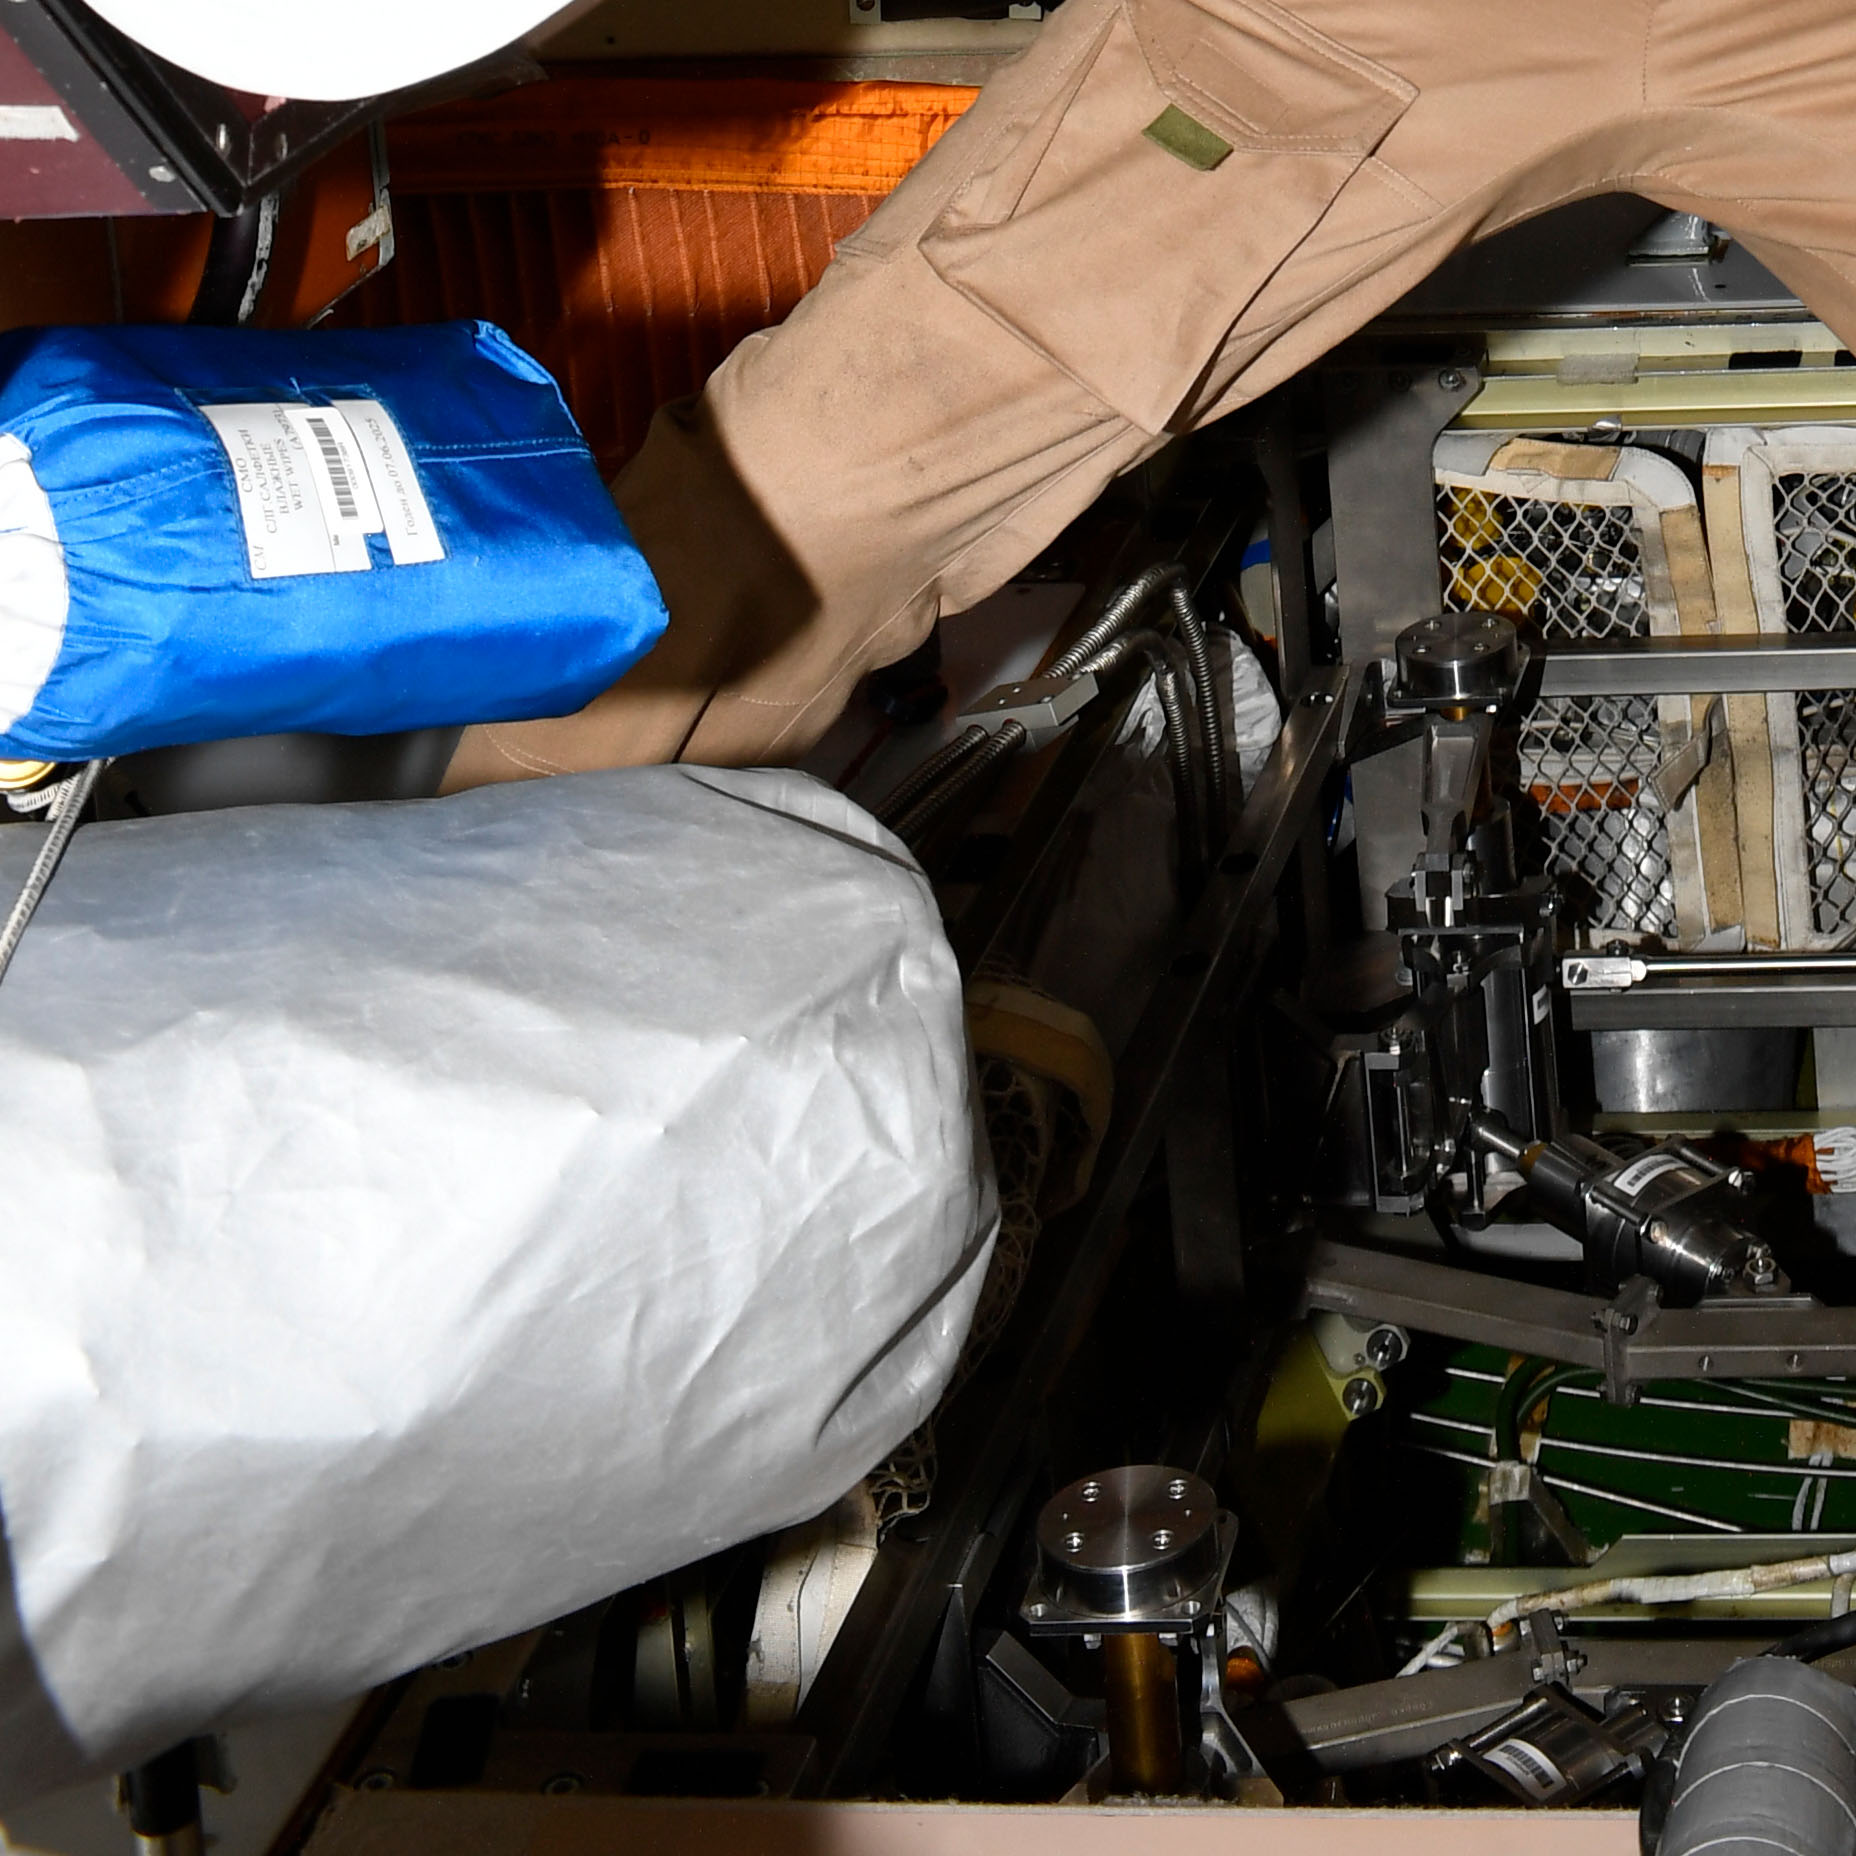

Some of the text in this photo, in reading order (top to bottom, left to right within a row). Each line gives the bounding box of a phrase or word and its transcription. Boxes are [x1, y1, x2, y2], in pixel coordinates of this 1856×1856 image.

[235, 456, 253, 493] СМО
[237, 428, 272, 502] САЛФЕТКИ
[261, 442, 290, 515] ВЛАЖНЫЕ
[274, 438, 304, 512] WET WIPES
